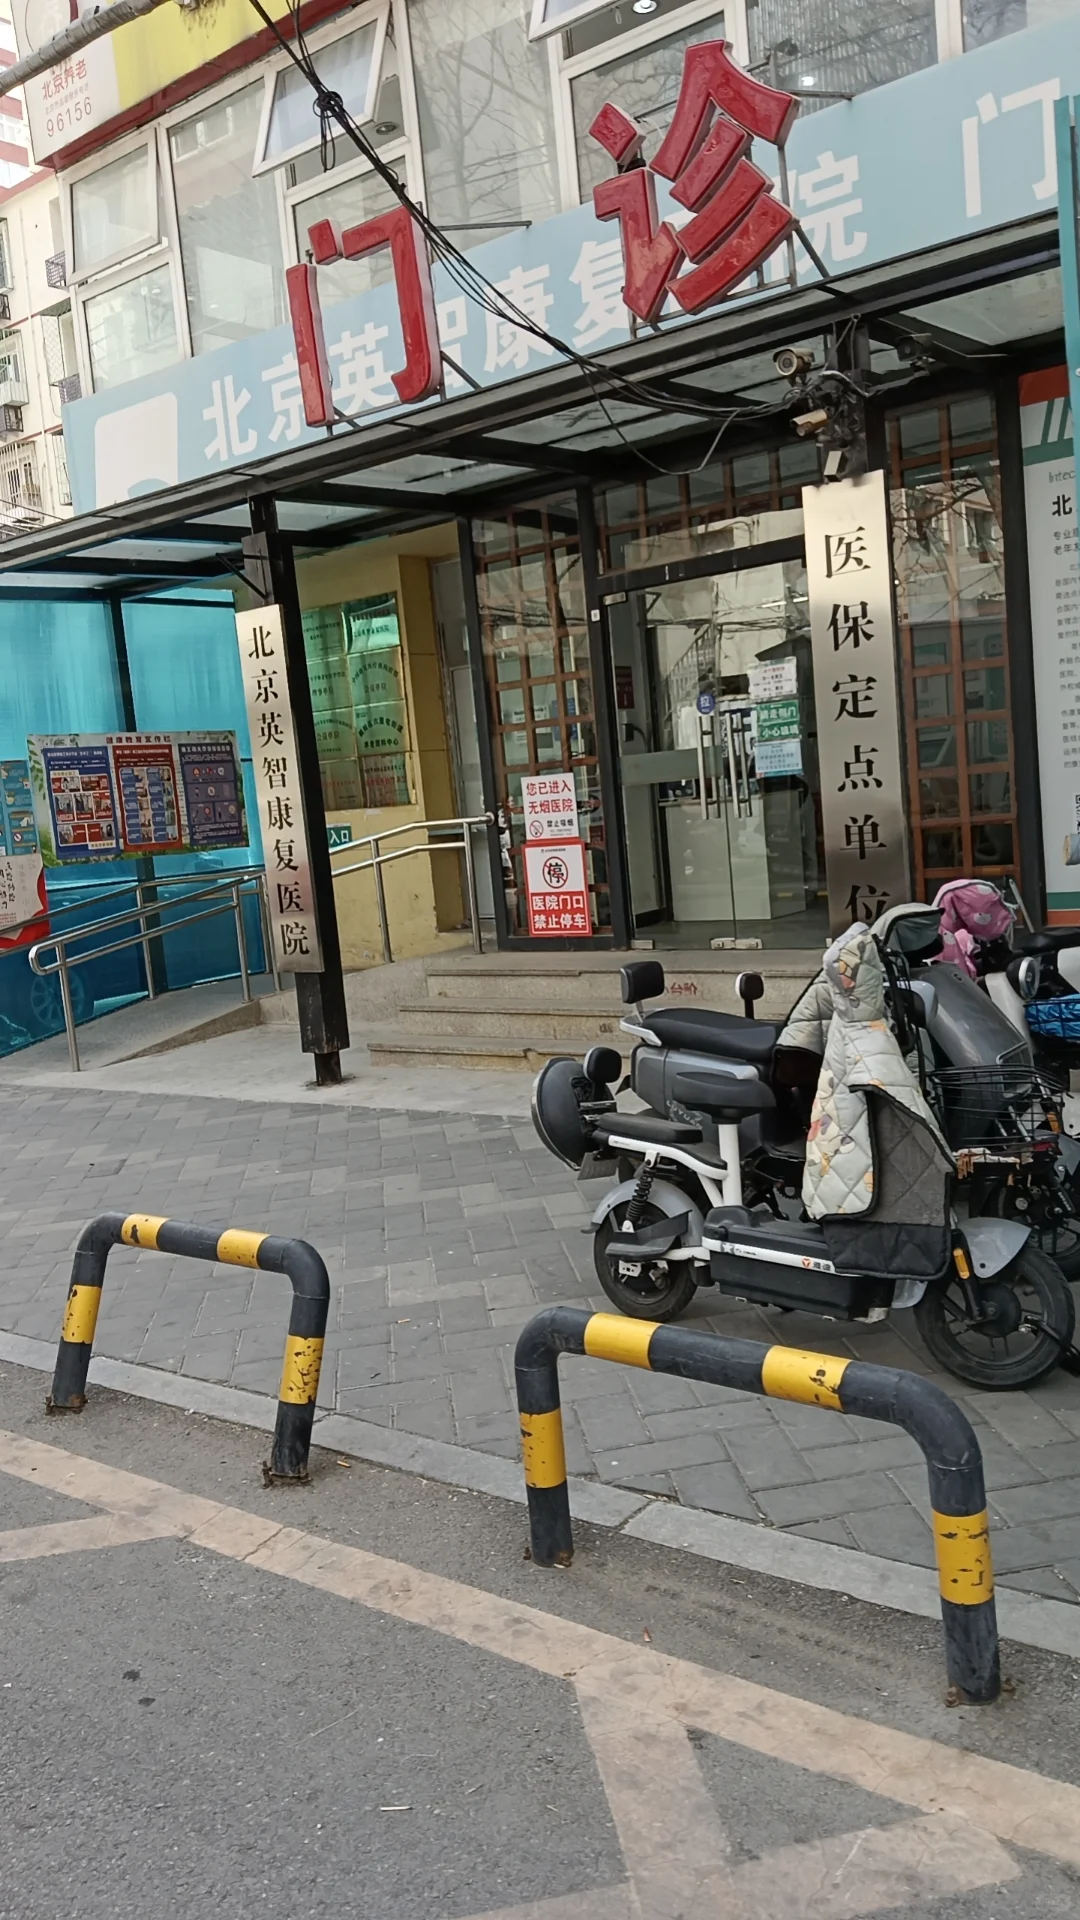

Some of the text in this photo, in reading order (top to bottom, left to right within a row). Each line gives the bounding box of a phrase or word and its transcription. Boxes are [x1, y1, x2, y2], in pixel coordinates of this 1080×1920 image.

[42, 58, 87, 100] 北京养老
[46, 96, 92, 137] 96156
[203, 151, 867, 461] 北京英康复院
[762, 724, 799, 738] 小心玻璃
[825, 527, 891, 922] 医保定点单位
[248, 626, 310, 956] 北京英智康复医院
[526, 780, 572, 796] 您已进入
[528, 798, 574, 815] 无烟医院
[546, 818, 574, 828] 禁止吸烟
[330, 829, 349, 844] 入口
[547, 861, 565, 884] 停
[532, 895, 585, 911] 医院门口
[533, 912, 587, 929] 禁止停车
[665, 982, 698, 995] 台阶
